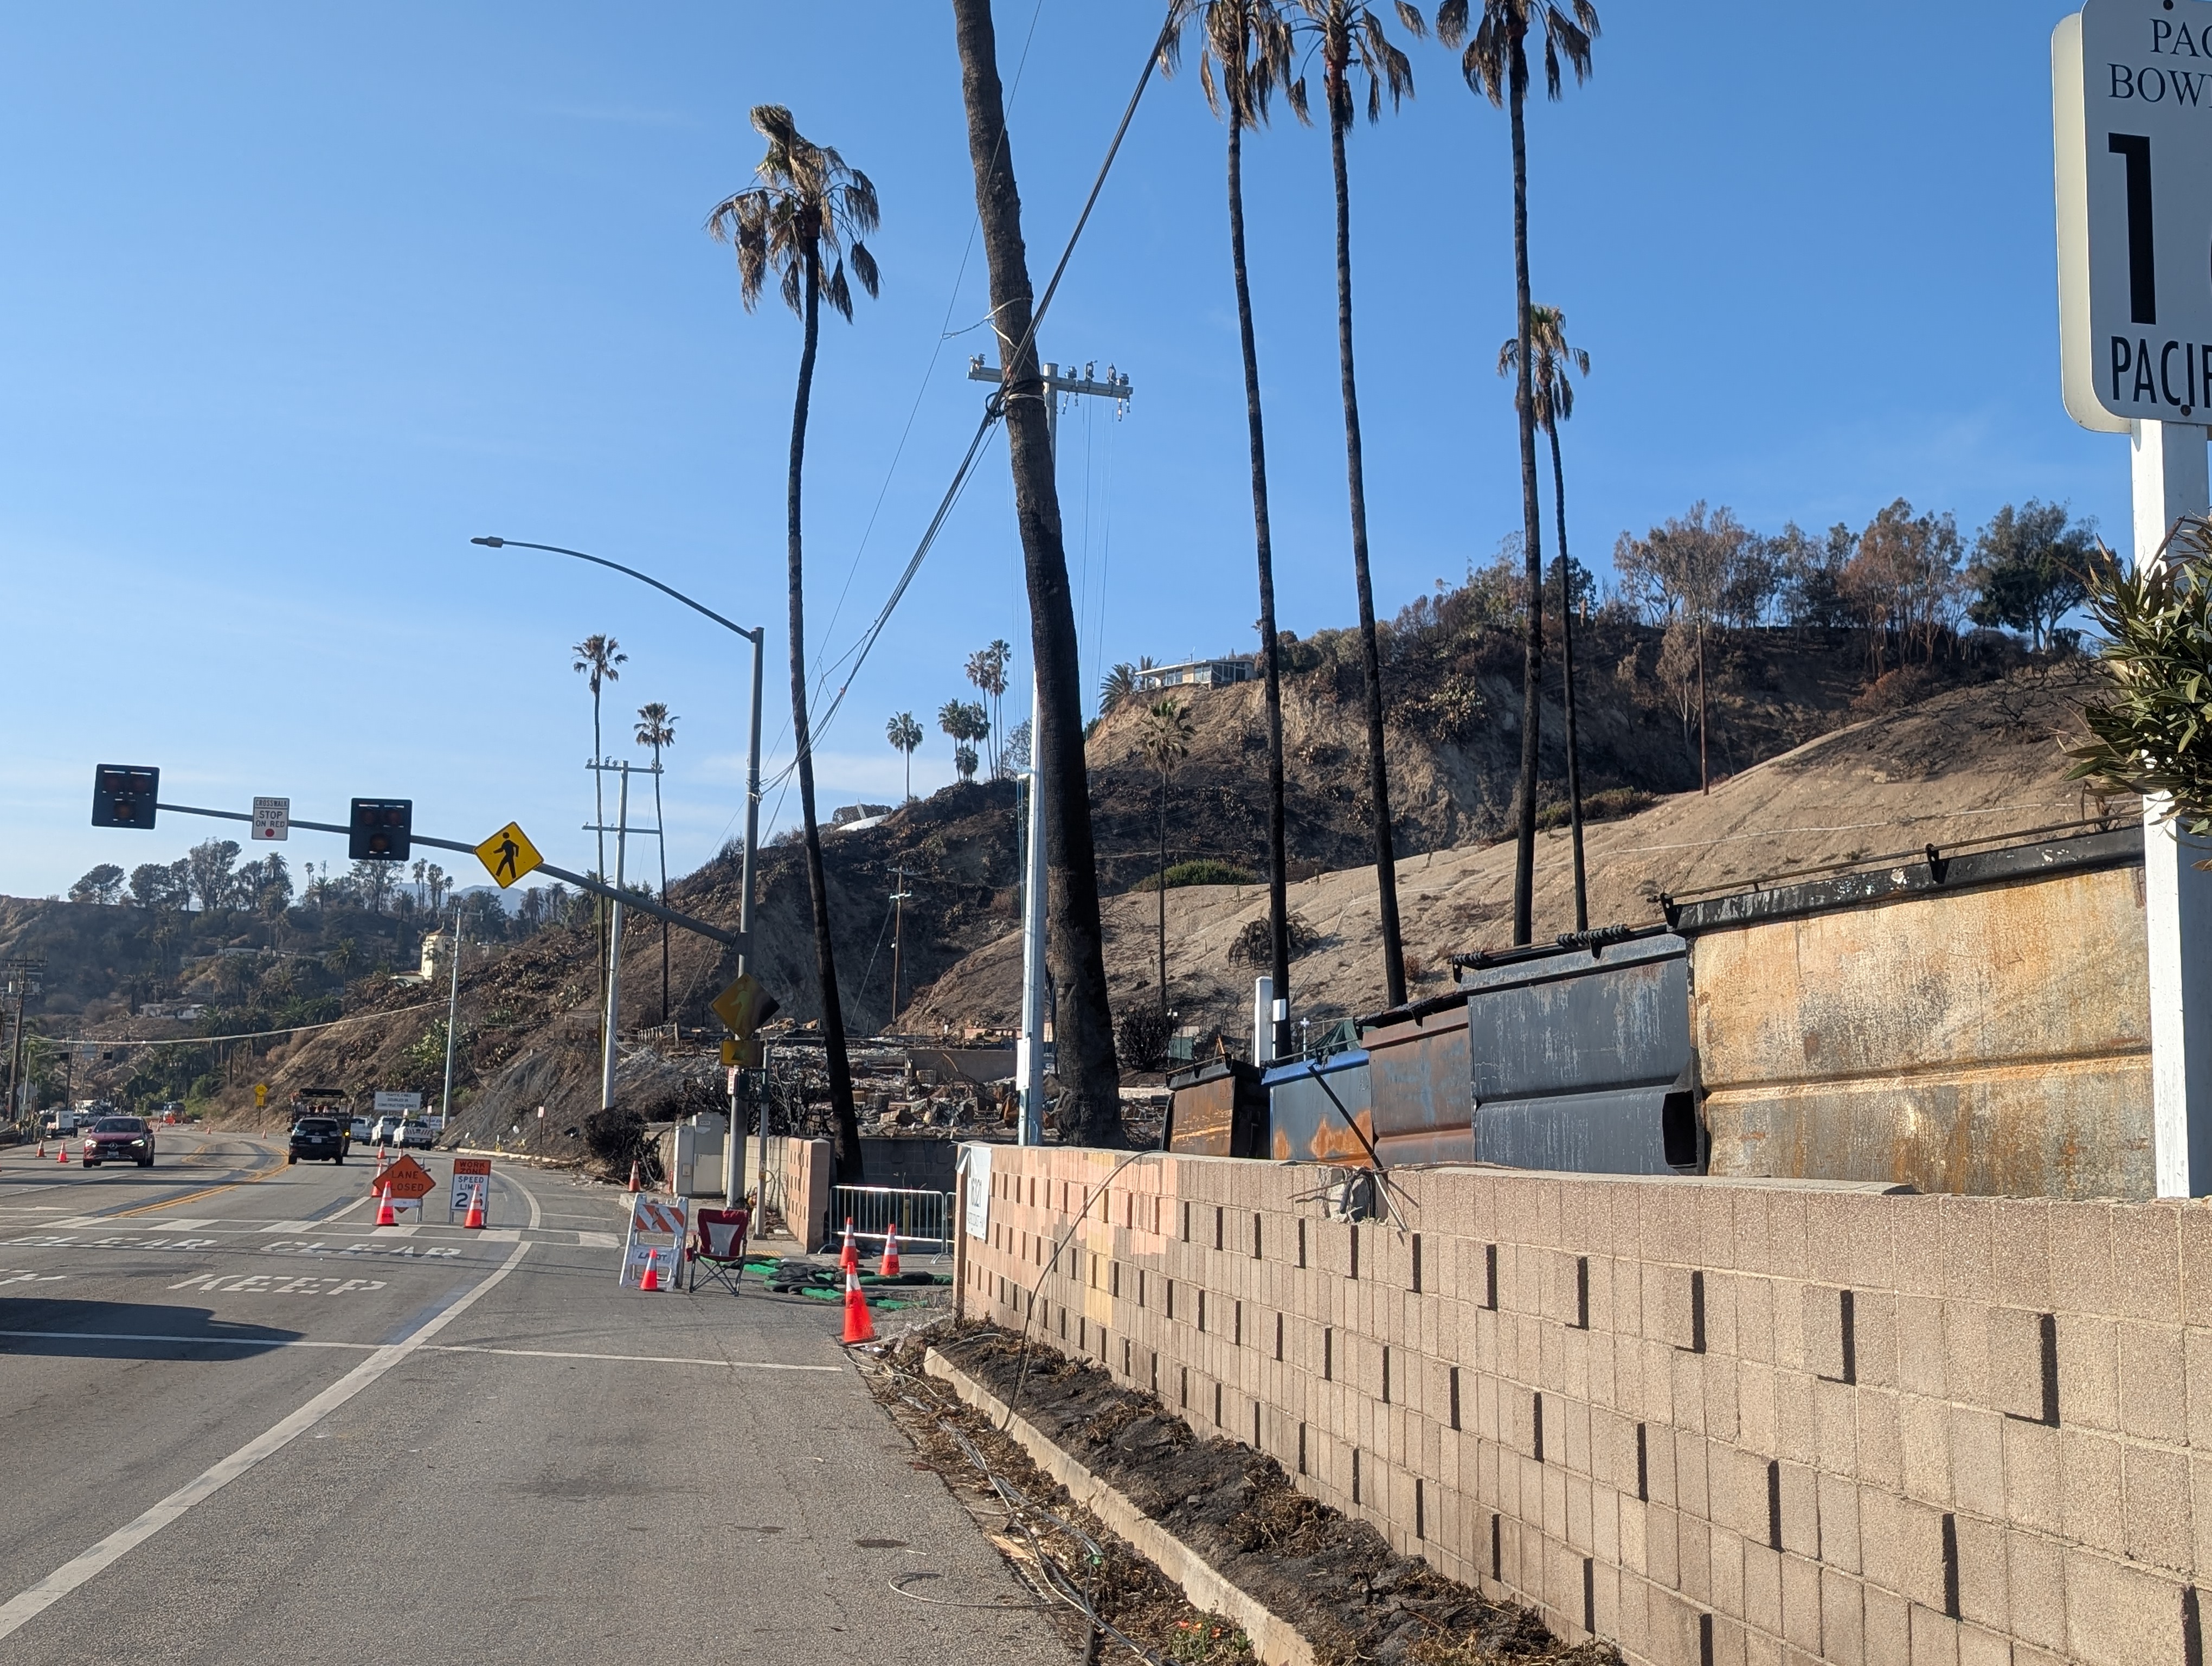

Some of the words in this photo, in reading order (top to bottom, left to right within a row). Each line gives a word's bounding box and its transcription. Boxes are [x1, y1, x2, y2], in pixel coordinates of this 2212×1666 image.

[2107, 63, 2212, 108] BOW
[259, 810, 282, 819] STOP
[270, 820, 285, 828] RED
[391, 1170, 419, 1179] LANE
[390, 1183, 424, 1191] LOSED
[0, 1236, 217, 1249] CLEAR
[260, 1241, 462, 1259] CLEAR
[166, 1273, 388, 1296] KEEP
